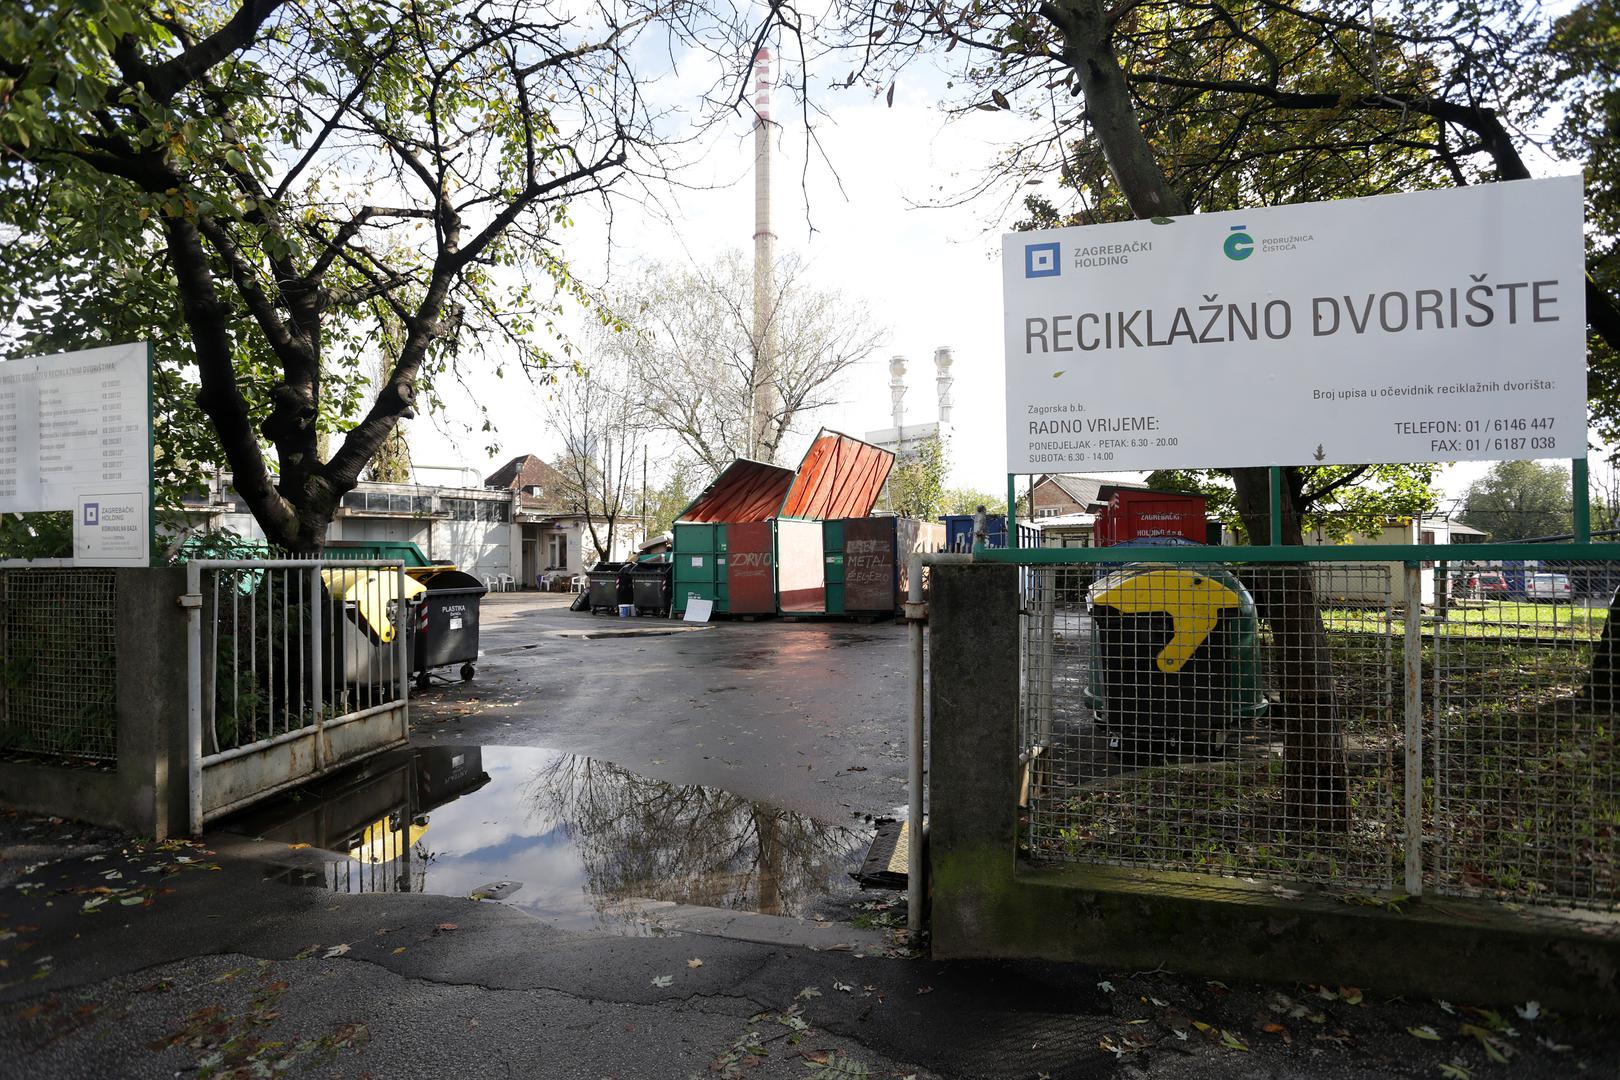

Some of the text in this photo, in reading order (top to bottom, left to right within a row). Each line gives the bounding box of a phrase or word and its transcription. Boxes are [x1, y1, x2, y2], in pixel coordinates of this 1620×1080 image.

[1262, 235, 1314, 245] PODRUŽNICA
[1074, 241, 1152, 258] ZAGREBAČKI
[1075, 254, 1128, 268] HOLDING
[1026, 273, 1559, 354] RECIKLAŽNO DVORIŠTE
[1314, 389, 1334, 400] Broj
[1339, 388, 1366, 400] upisa
[1381, 385, 1433, 396] očevidnik
[1437, 382, 1499, 393] reciklažnih
[1504, 379, 1554, 391] dvorišta:
[1028, 403, 1086, 415] Zagorska b.b.
[1030, 417, 1159, 434] RADNO VRIJEME:
[1394, 421, 1461, 434] TELEFON:
[1466, 420, 1479, 432] 01
[1495, 419, 1526, 431] 6146
[1531, 418, 1554, 429] 447
[1029, 440, 1091, 450] PONEDJELJAK
[1099, 439, 1129, 448] PETAK:
[1131, 439, 1148, 447] 6.30
[1156, 437, 1178, 446] 20.00
[1432, 440, 1461, 452] FAX:
[1466, 439, 1479, 451] 01
[1495, 438, 1526, 450] 6187
[1531, 437, 1555, 449] 038
[1030, 454, 1066, 462] SUBOTA:
[1068, 453, 1084, 461] 6.30
[1093, 452, 1113, 461] 14.00
[730, 553, 772, 566] DRVO
